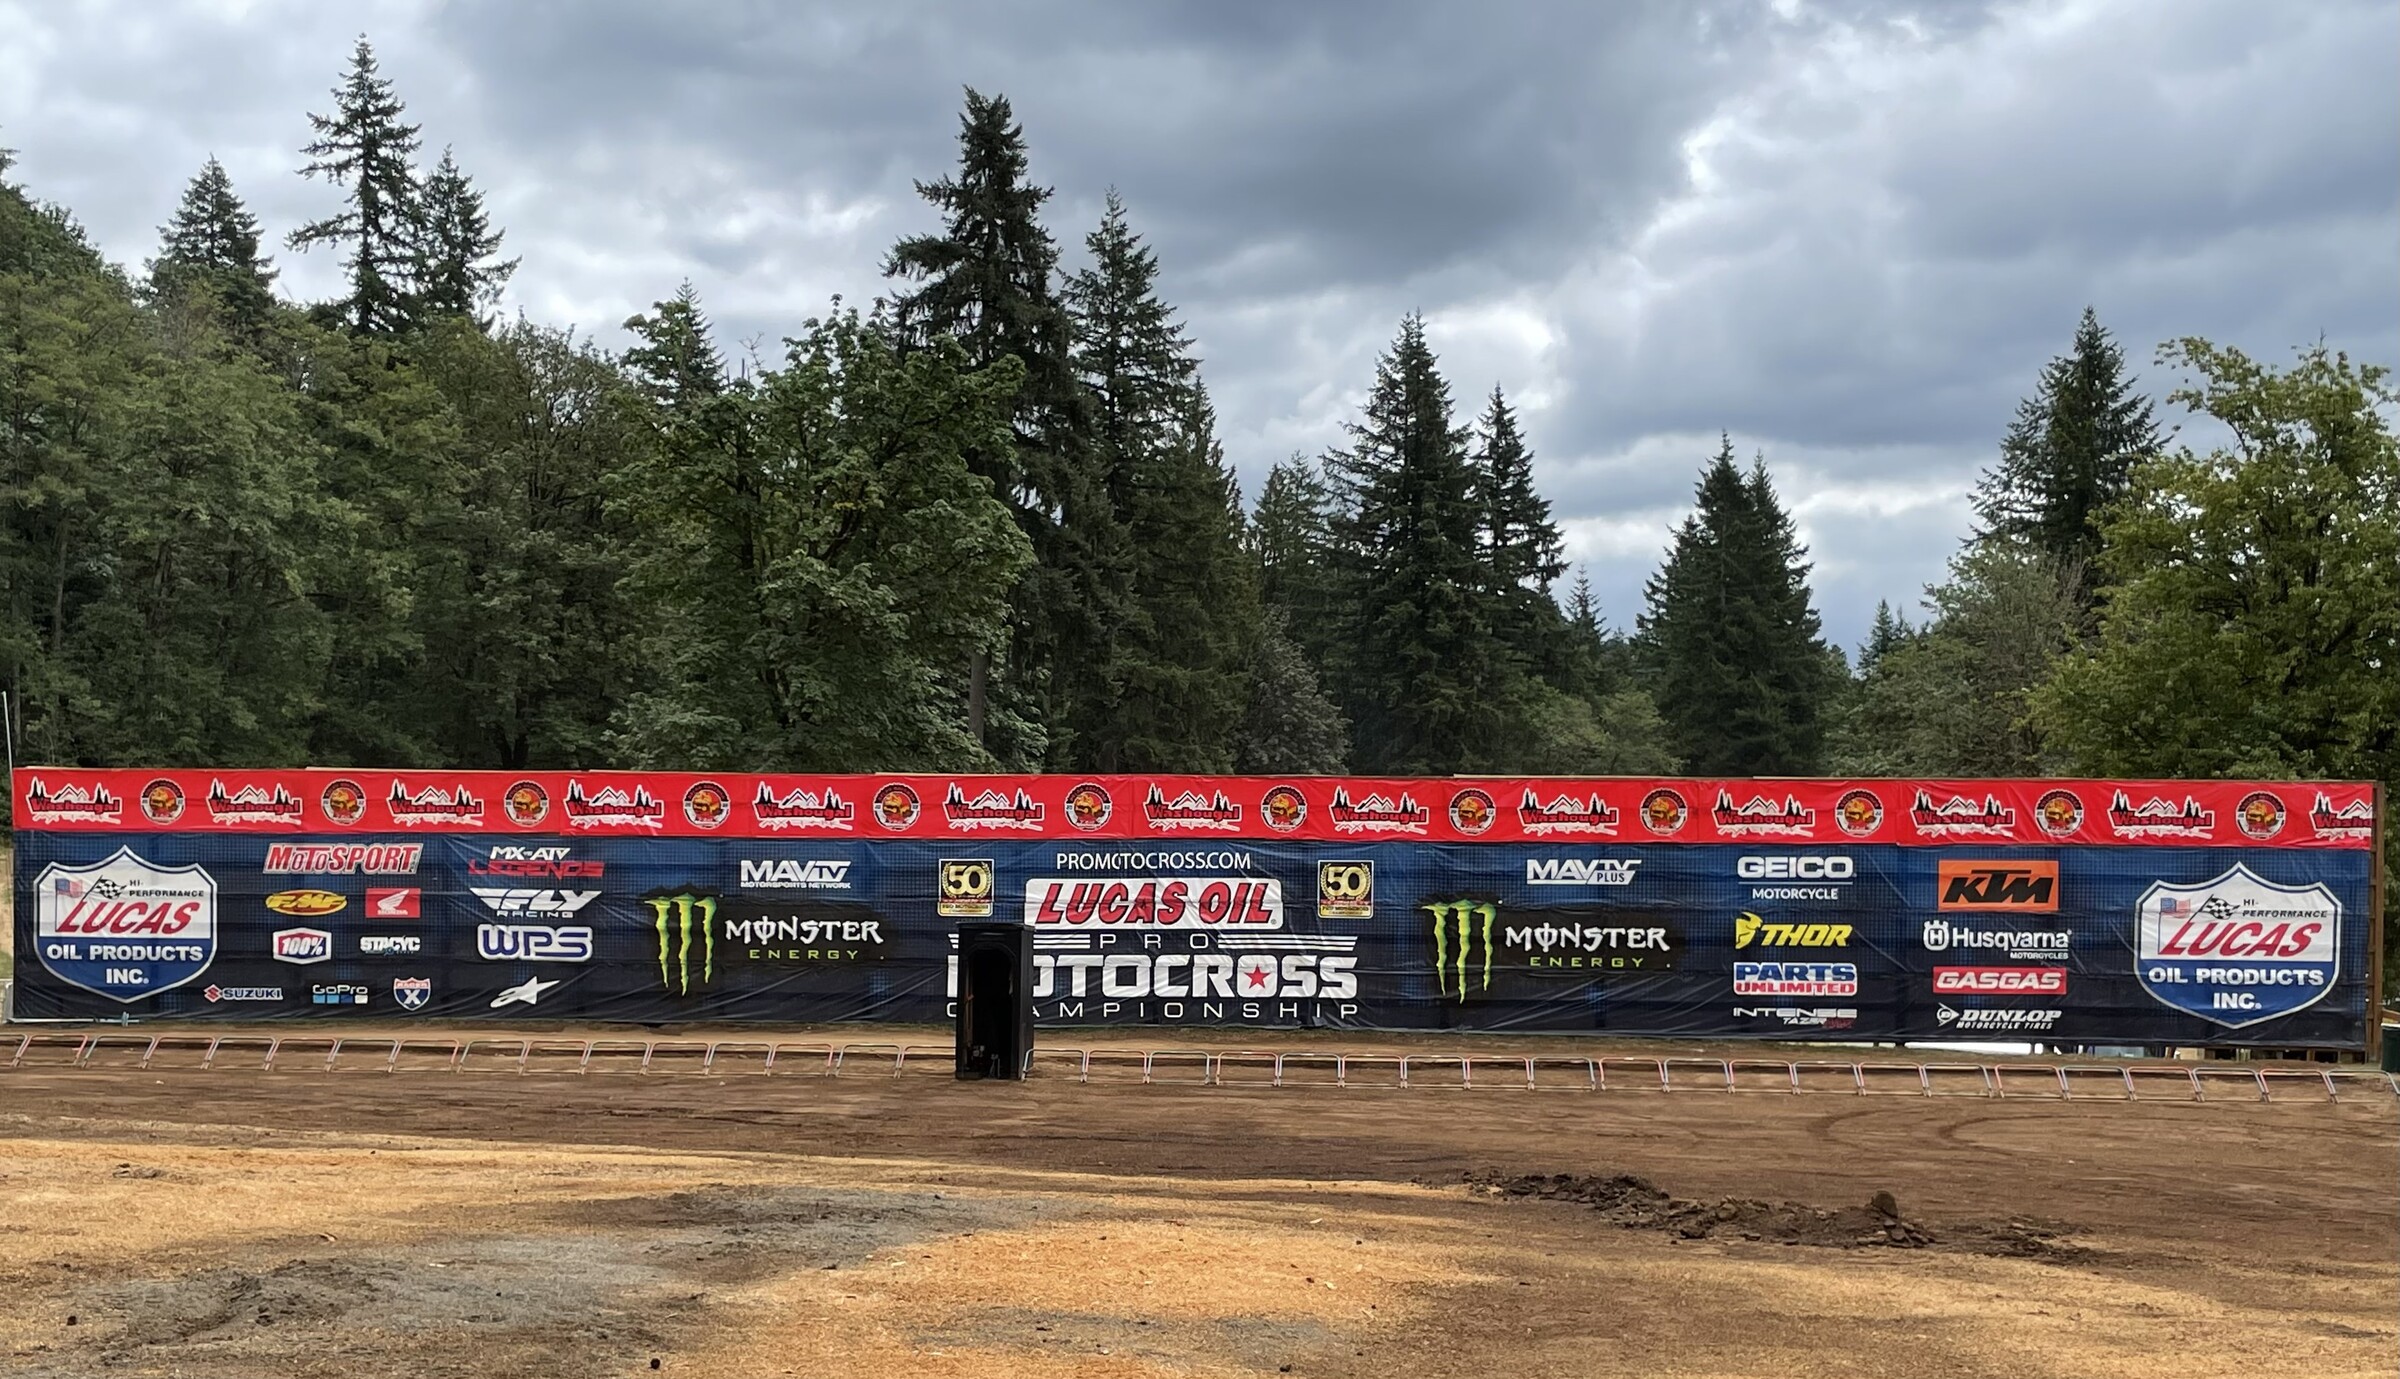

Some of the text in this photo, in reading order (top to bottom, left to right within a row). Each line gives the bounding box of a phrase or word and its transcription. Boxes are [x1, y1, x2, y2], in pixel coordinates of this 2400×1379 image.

[31, 798, 120, 814] Washougal
[208, 798, 301, 814] Washougal
[389, 799, 483, 815] Washougal
[567, 800, 662, 817] Washougal
[755, 802, 852, 819] Washougal
[945, 804, 1044, 821] Washougal
[1146, 804, 1239, 821] Washougal
[1331, 806, 1428, 823] Washougal
[1519, 808, 1617, 826] Washougal
[1714, 810, 1814, 827] Washougal
[1912, 810, 2013, 828] Washougal
[2110, 811, 2212, 829] Washougal
[468, 859, 604, 880] LEGENDS
[1056, 852, 1251, 870] PROMOTOCROSS.COM
[1737, 856, 1853, 878] GEICO
[740, 860, 851, 882] MAVTV
[1526, 859, 1642, 881] MAVTV
[1596, 872, 1625, 882] PLUS
[948, 865, 987, 895] 50
[1327, 866, 1367, 896] 50
[1943, 869, 2054, 903] KTM
[266, 893, 346, 908] FMF
[470, 888, 602, 911] FLY
[1752, 888, 1838, 900] MOTORCYCLE
[1035, 882, 1274, 925] LUCAS OIL
[56, 902, 201, 933] LUCAS
[2242, 910, 2328, 918] PERFORMANCE
[725, 916, 883, 945] MONSTER
[1505, 922, 1670, 952] MONSTER
[1758, 924, 1853, 947] THOR
[1952, 927, 2068, 951] Husqvarna
[282, 937, 323, 955] 100%
[360, 936, 421, 952] STACYC
[480, 927, 590, 958] WPS
[1099, 934, 1209, 949] PRO
[2158, 922, 2322, 957] LUCAS
[47, 945, 203, 961] OIL PRODUCTS
[749, 950, 858, 960] ENERGY
[1529, 957, 1644, 967] ENERGY
[946, 955, 1358, 999] TOCROSS
[1736, 965, 1855, 981] PARTS
[1936, 971, 2062, 989] GASGAS
[2148, 967, 2324, 986] OIL PRODUCTS
[222, 988, 282, 1000] SUZUKI
[312, 984, 368, 995] GoPro
[1735, 982, 1855, 993] UNLIMITED
[404, 990, 420, 1004] X
[946, 1002, 1358, 1019] CMPIONSHIP
[1733, 1007, 1857, 1018] INTENSE
[1960, 1010, 2062, 1022] DUNLOP
